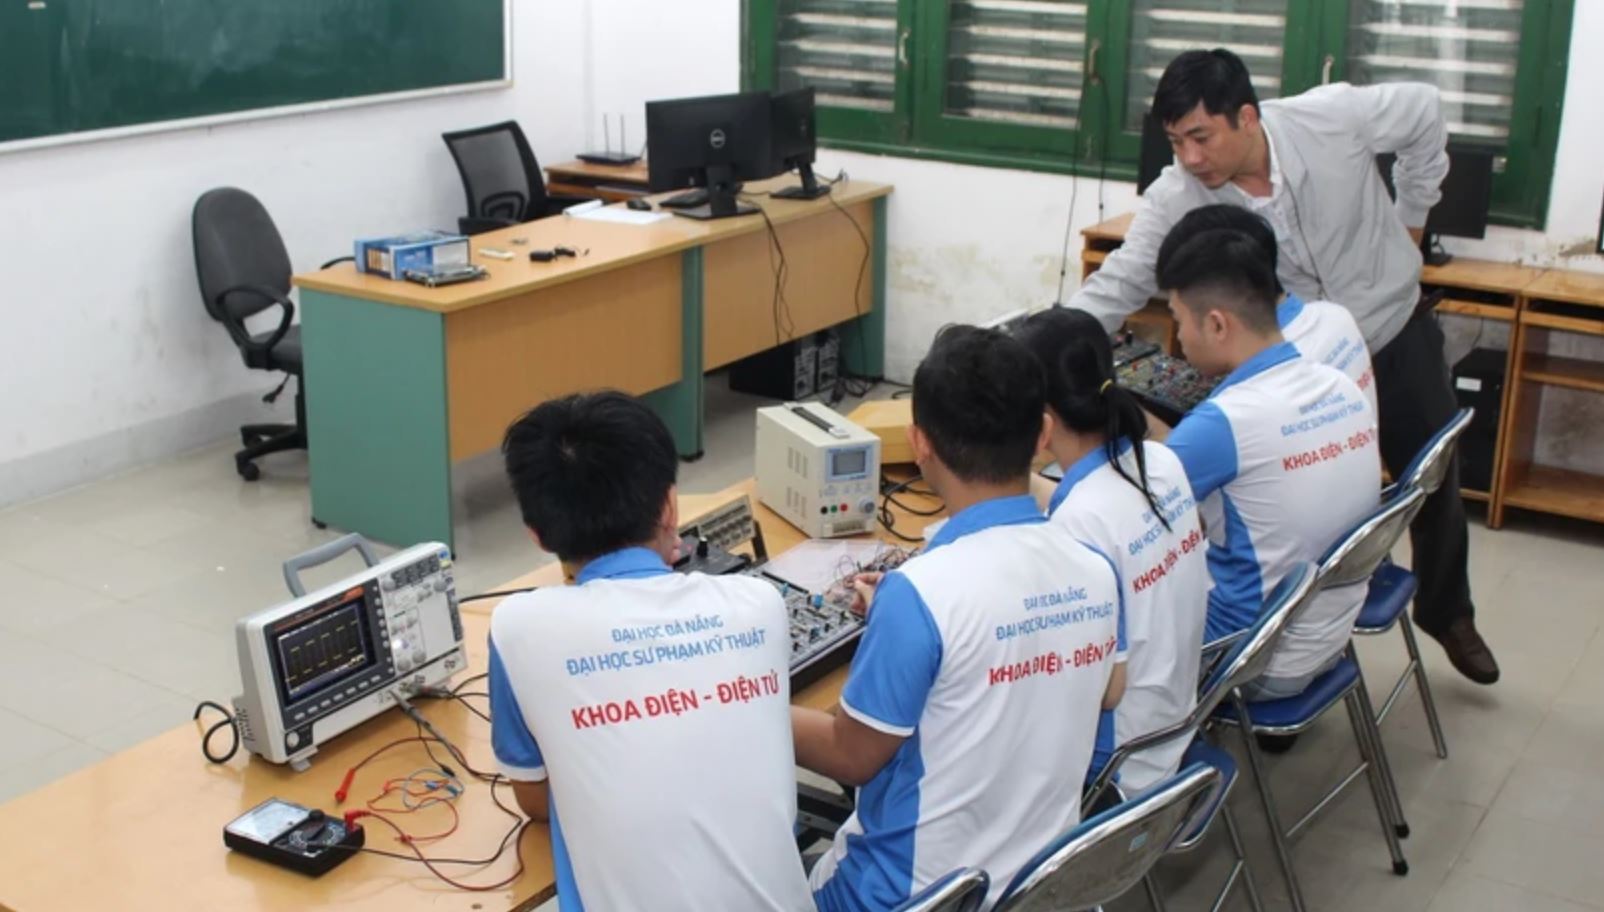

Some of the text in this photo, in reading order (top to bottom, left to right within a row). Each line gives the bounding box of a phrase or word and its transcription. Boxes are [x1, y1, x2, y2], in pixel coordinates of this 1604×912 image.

[1283, 450, 1320, 471] KHOA
[1133, 563, 1166, 593] KHOA
[611, 628, 636, 643] ĐẠI
[636, 624, 664, 640] HỌC
[665, 619, 684, 636] ĐÀ
[566, 656, 596, 676] ĐẠI
[597, 651, 632, 671] HỌC
[655, 641, 704, 662] PHẠM
[725, 627, 766, 650] THUẬT
[989, 659, 1031, 686] KHOA
[1074, 642, 1103, 668] ĐIỆN
[571, 700, 641, 729] KHOA
[644, 688, 698, 717] ĐIỆN
[717, 676, 760, 704] ĐIỆN
